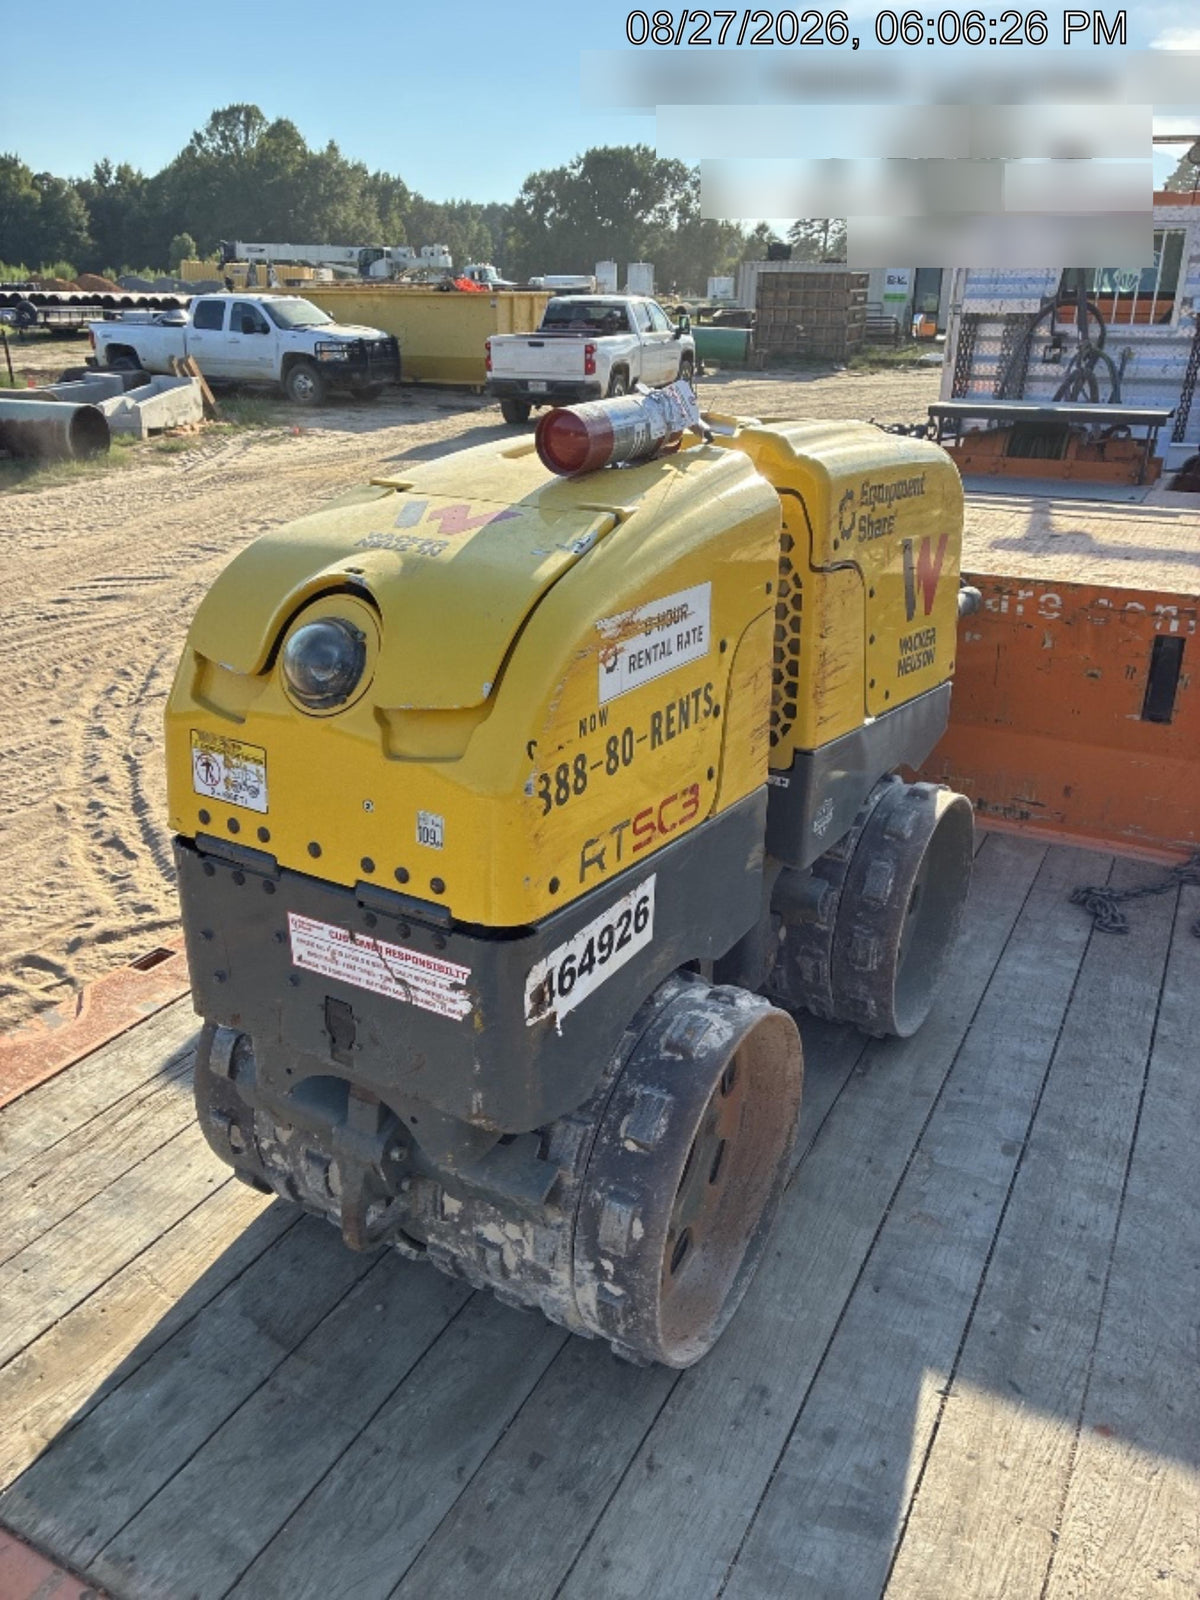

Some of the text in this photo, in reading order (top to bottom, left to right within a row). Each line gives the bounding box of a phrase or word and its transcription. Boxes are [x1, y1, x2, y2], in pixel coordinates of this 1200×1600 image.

[859, 472, 926, 512] Equipment
[857, 512, 896, 543] Share
[628, 637, 673, 674] RENTAL
[676, 625, 704, 652] RATE
[898, 627, 936, 656] WACKER
[896, 647, 936, 679] NEUSON
[578, 706, 610, 739] NOW
